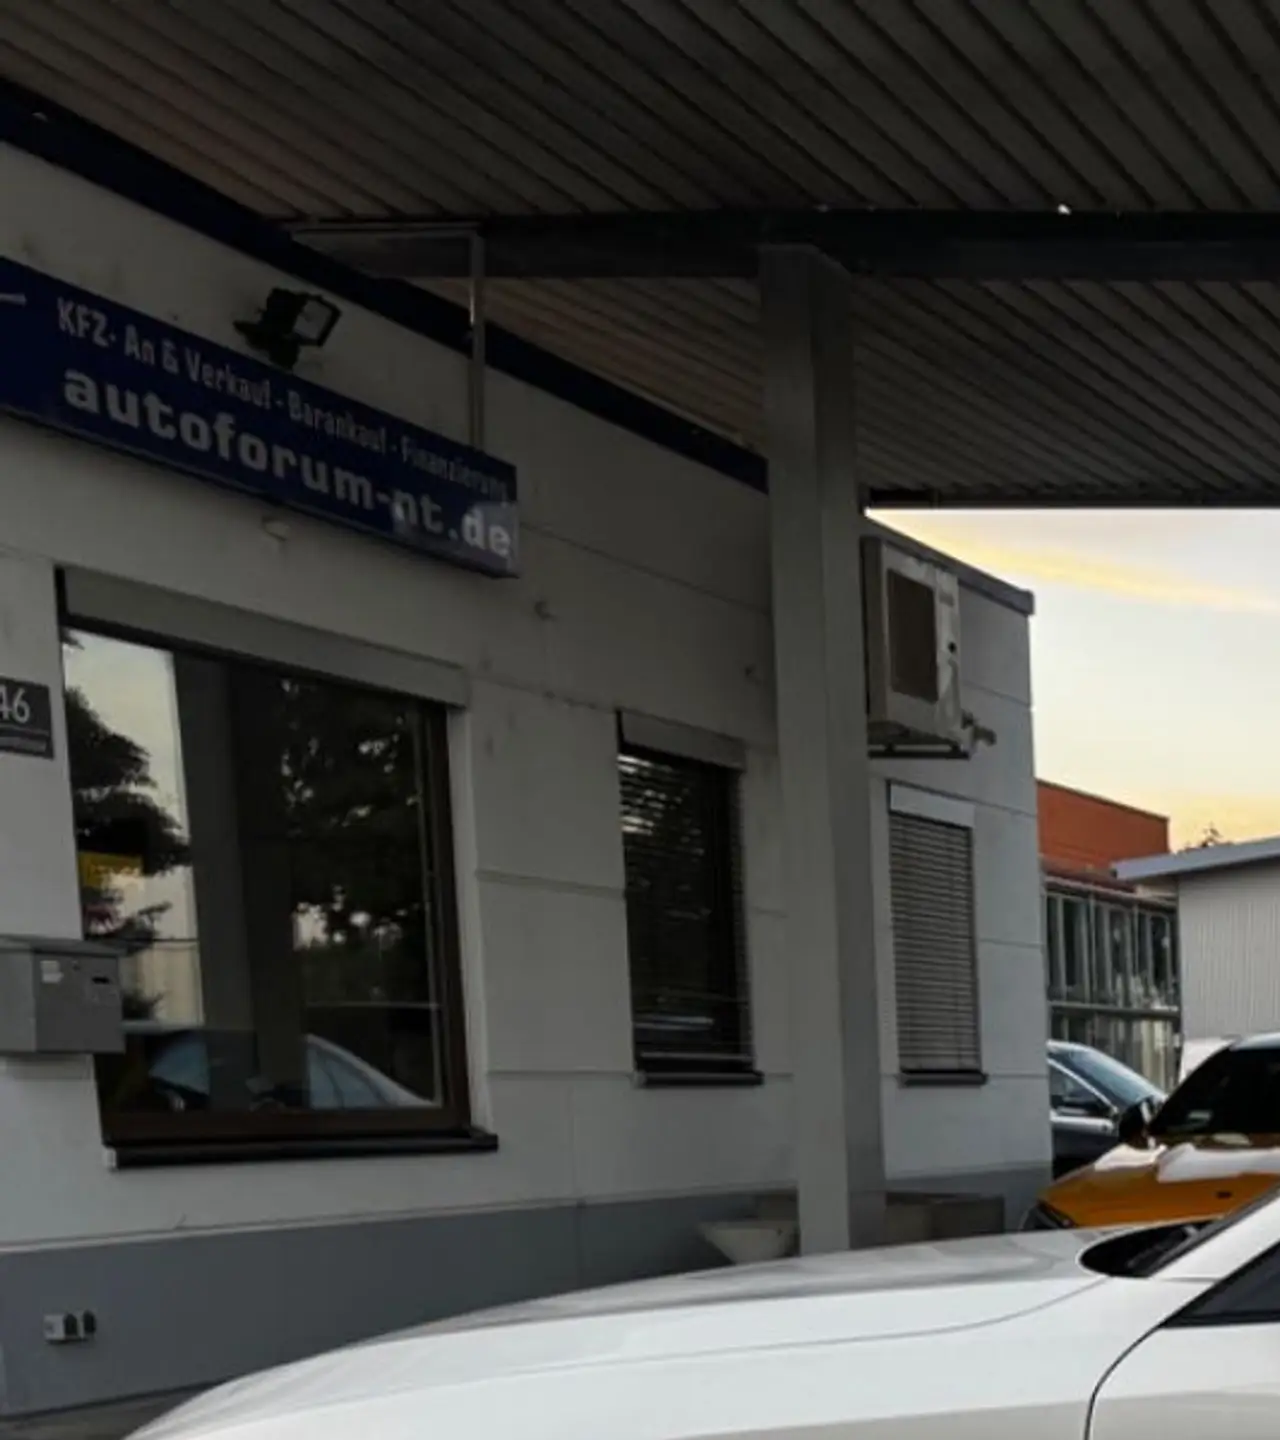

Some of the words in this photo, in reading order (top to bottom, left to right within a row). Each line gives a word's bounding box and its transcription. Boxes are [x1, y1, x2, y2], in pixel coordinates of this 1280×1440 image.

[124, 323, 155, 367] An
[161, 337, 180, 375] &
[185, 346, 271, 410] Verkauf
[63, 368, 512, 557] autoforum-nt.de
